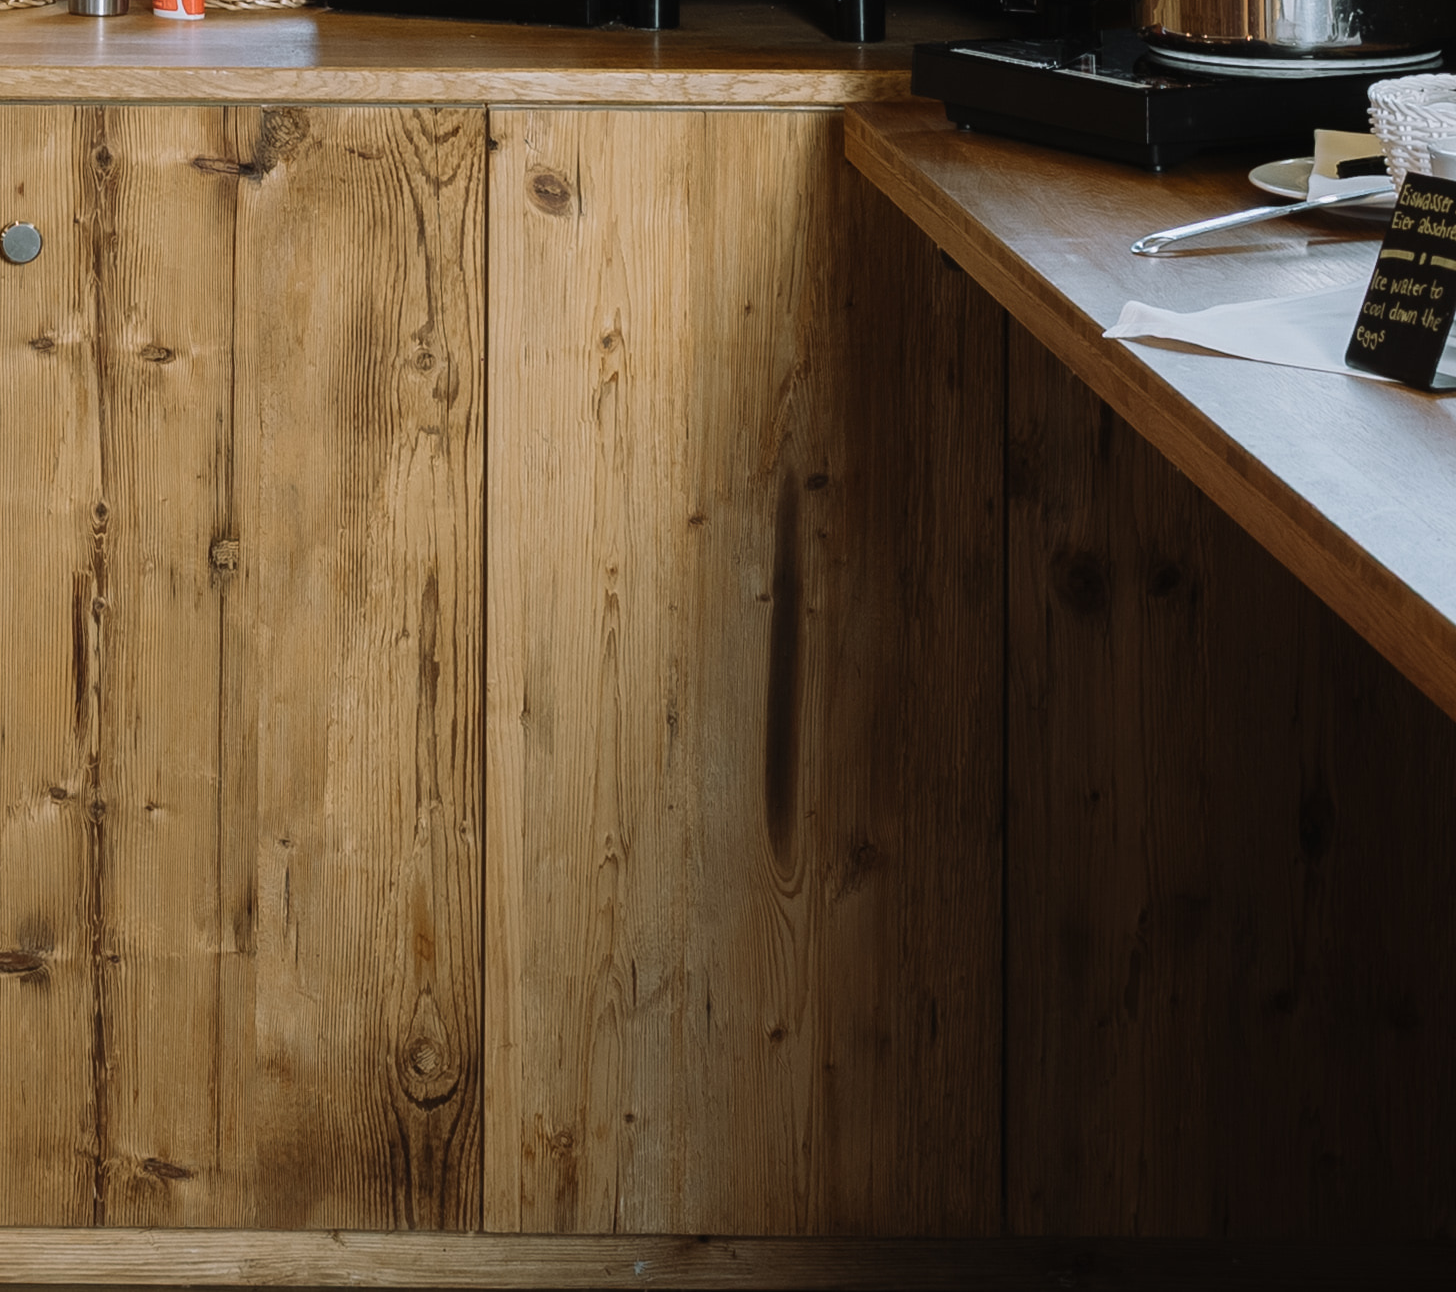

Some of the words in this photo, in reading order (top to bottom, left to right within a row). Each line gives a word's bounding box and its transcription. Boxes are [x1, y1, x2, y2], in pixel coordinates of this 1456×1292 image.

[1399, 182, 1454, 214] Eiswasser
[1391, 210, 1415, 230] Eier
[1370, 268, 1388, 292] Ice
[1390, 277, 1428, 298] water
[1429, 279, 1444, 299] to
[1363, 300, 1386, 320] cool
[1389, 301, 1418, 326] down
[1421, 307, 1443, 333] the
[1356, 324, 1386, 351] eggs
